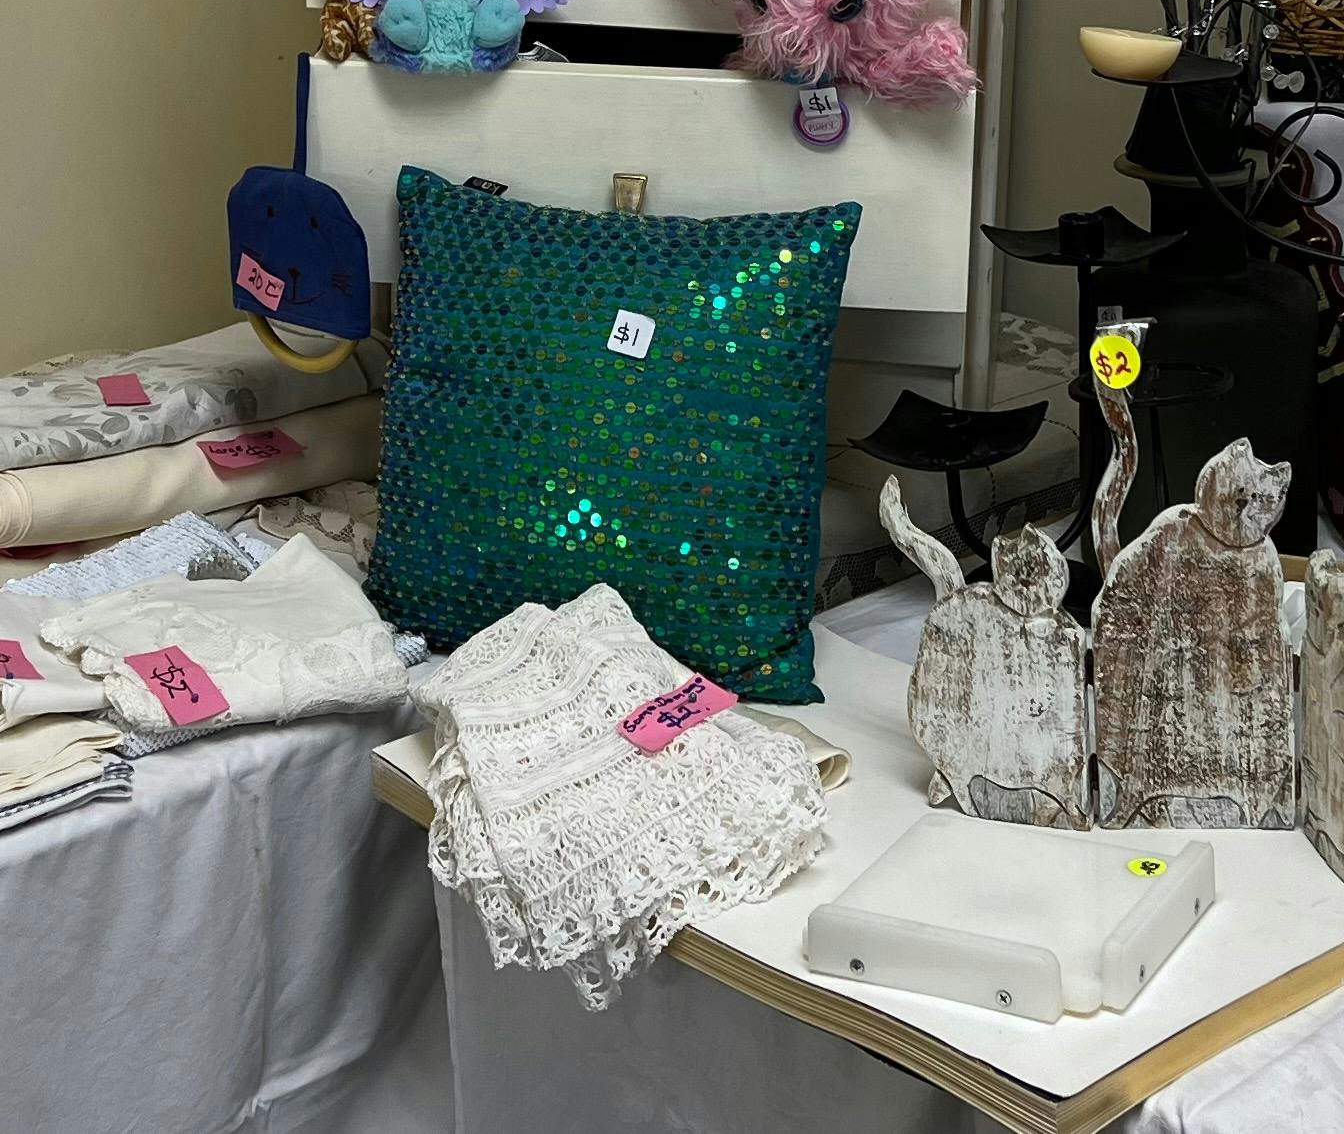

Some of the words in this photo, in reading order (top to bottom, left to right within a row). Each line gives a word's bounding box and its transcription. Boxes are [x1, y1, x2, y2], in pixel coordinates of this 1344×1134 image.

[809, 92, 832, 114] $1
[614, 322, 639, 346] $1
[1096, 351, 1131, 384] $2
